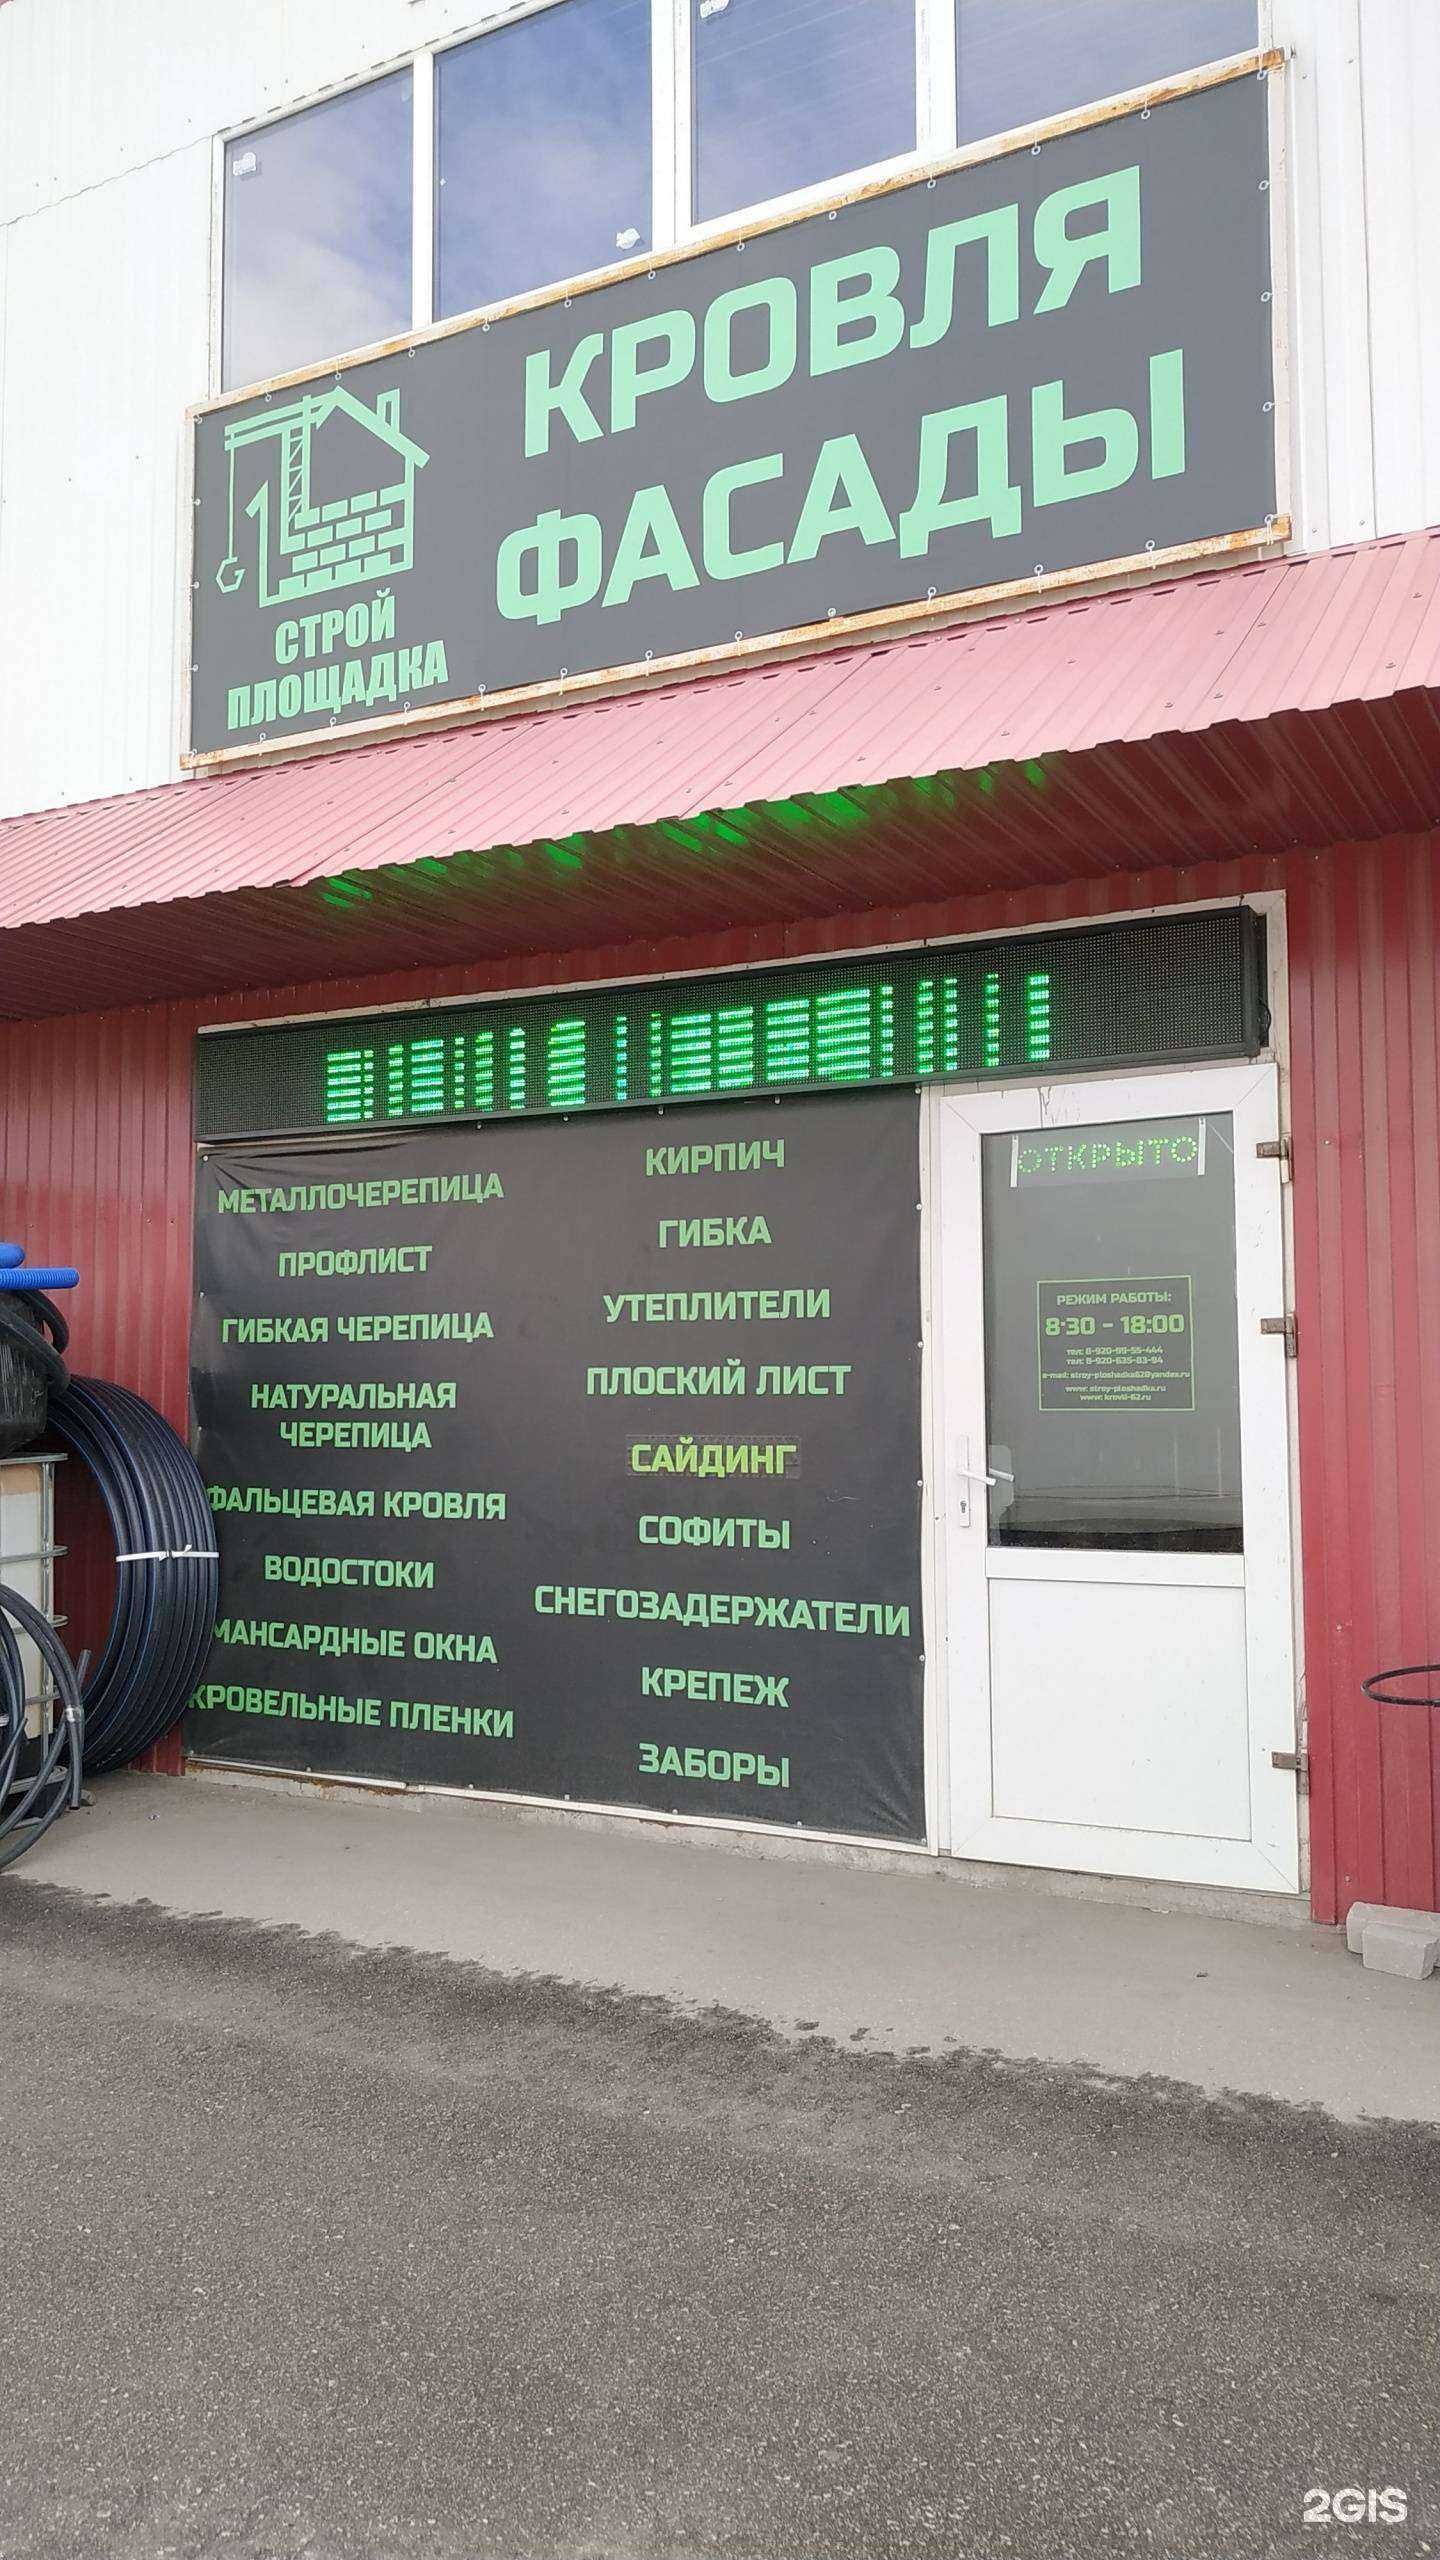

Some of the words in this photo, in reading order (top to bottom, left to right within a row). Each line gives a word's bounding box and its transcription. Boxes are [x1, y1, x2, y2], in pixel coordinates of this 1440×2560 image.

[523, 164, 1143, 459] КРОВЛЯ
[495, 348, 1187, 626] ФАСАДЫ
[273, 587, 397, 666] СТРОЙ
[226, 639, 450, 731] ПЛОЩАДКА
[645, 1137, 784, 1175] КИРПИЧ
[1018, 1134, 1198, 1174] ОТКРЫТО
[217, 1172, 504, 1214] МЕТАЛЛОЧЕРЕПИЦА
[659, 1216, 772, 1248] ГИБКА
[279, 1245, 432, 1277] ПРОФЛИСТ
[603, 1288, 831, 1323] УТЕПЛИТЕЛИ
[1056, 1294, 1107, 1306] РЕЖИМ
[1110, 1291, 1172, 1304] РАБОТЫ:
[223, 1315, 328, 1342] ГИБКАЯ
[338, 1312, 494, 1342] ЧЕРЕПИЦА
[1120, 1314, 1185, 1334] 18:00
[252, 1382, 456, 1409] НАТУРАЛЬНАЯ
[586, 1358, 746, 1396] ПЛОСКИЙ
[757, 1365, 851, 1395] ЛИСТ
[281, 1422, 431, 1451] ЧЕРЕПИЦА
[631, 1436, 797, 1478] САЙДИНГ
[207, 1486, 374, 1518] ФАЛЬЦЕВАЯ
[384, 1492, 505, 1519] КРОВЛЯ
[639, 1515, 789, 1548] СОФИТЫ
[265, 1555, 433, 1588] ВОДОСТОКИ
[535, 1586, 910, 1637] СНЕГОЗАДЕРЖАТЕЛИ
[215, 1619, 405, 1657] МАНСАРДНЫЕ
[414, 1632, 496, 1663] ОКНА
[642, 1667, 789, 1707] КРЕПЕЖ
[190, 1685, 381, 1725] КРОВЕЛЬНЫЕ
[390, 1701, 513, 1737] ПЛЕНКИ
[639, 1743, 789, 1788] ЗАБОРЫ
